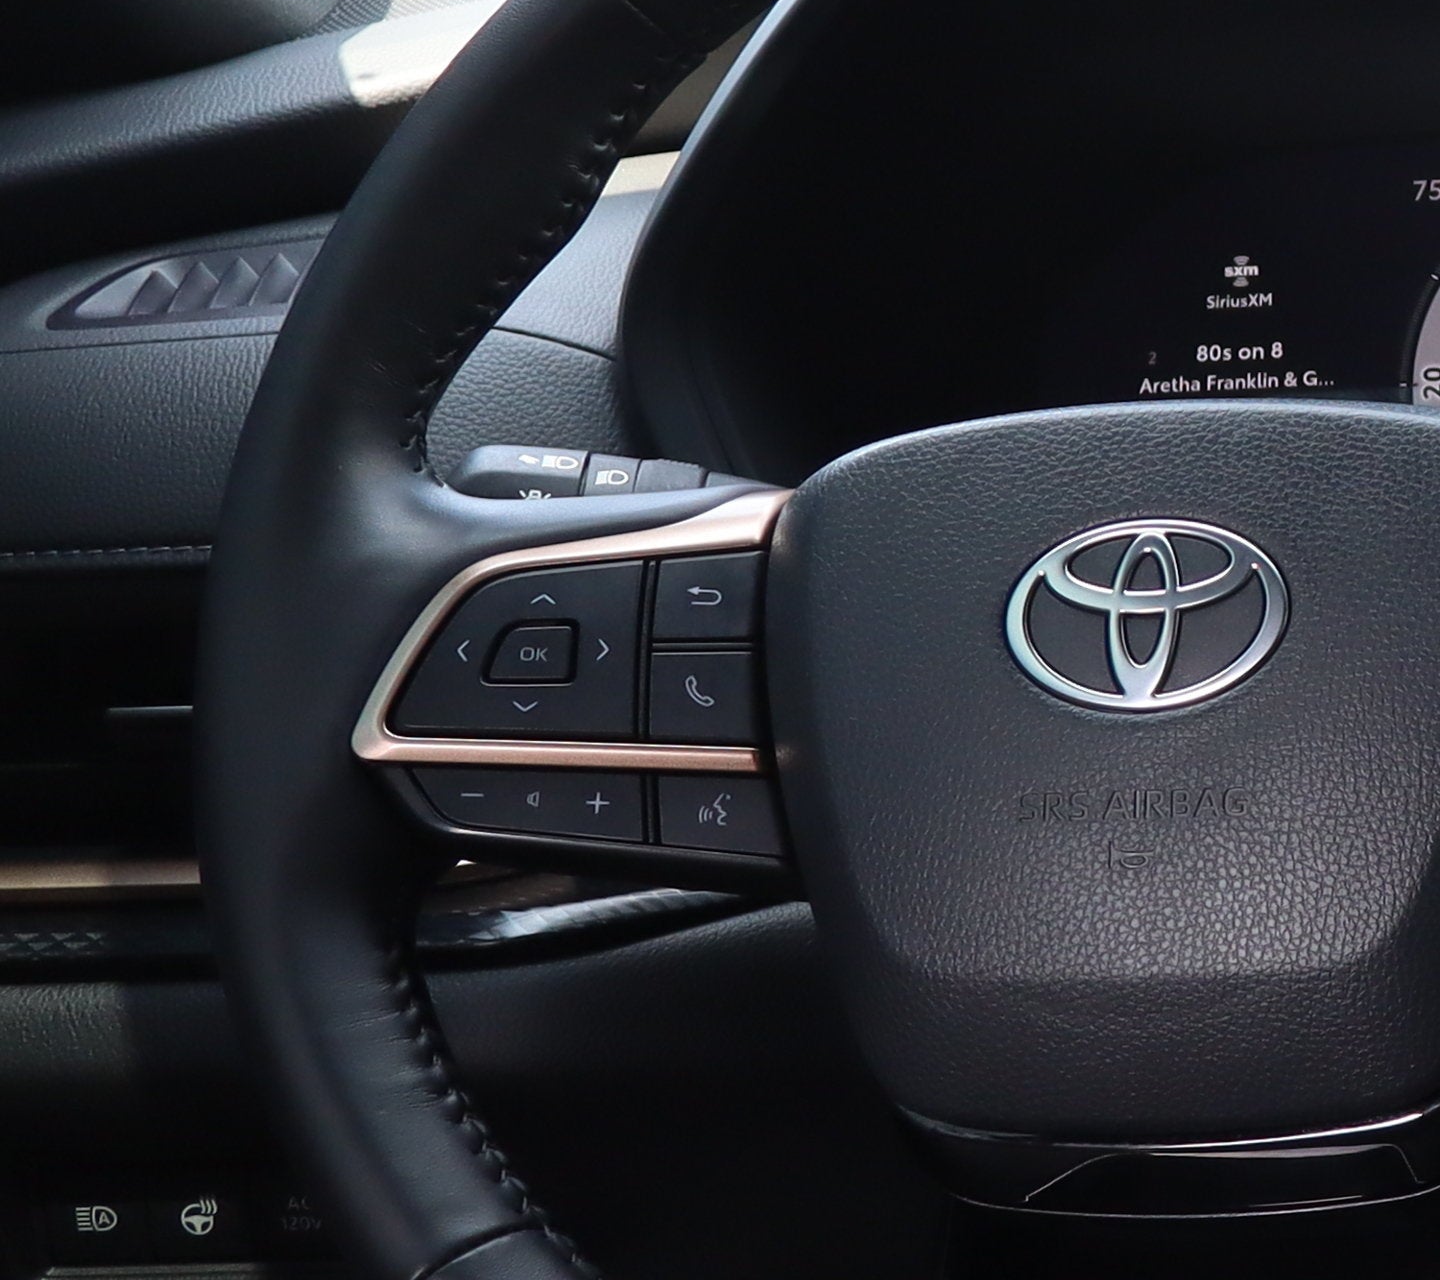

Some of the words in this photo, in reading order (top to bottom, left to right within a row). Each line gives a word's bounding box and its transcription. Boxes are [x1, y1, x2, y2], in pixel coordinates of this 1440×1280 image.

[1206, 292, 1273, 309] SiriusXM
[1196, 343, 1232, 362] 80s
[1237, 345, 1265, 361] on
[1270, 342, 1284, 359] 8
[1139, 376, 1201, 395] Aretha
[1206, 371, 1279, 392] Franklin
[1283, 371, 1298, 388] &
[519, 647, 548, 662] OK
[1019, 789, 1090, 822] SRS
[1102, 786, 1249, 821] AIRBAG
